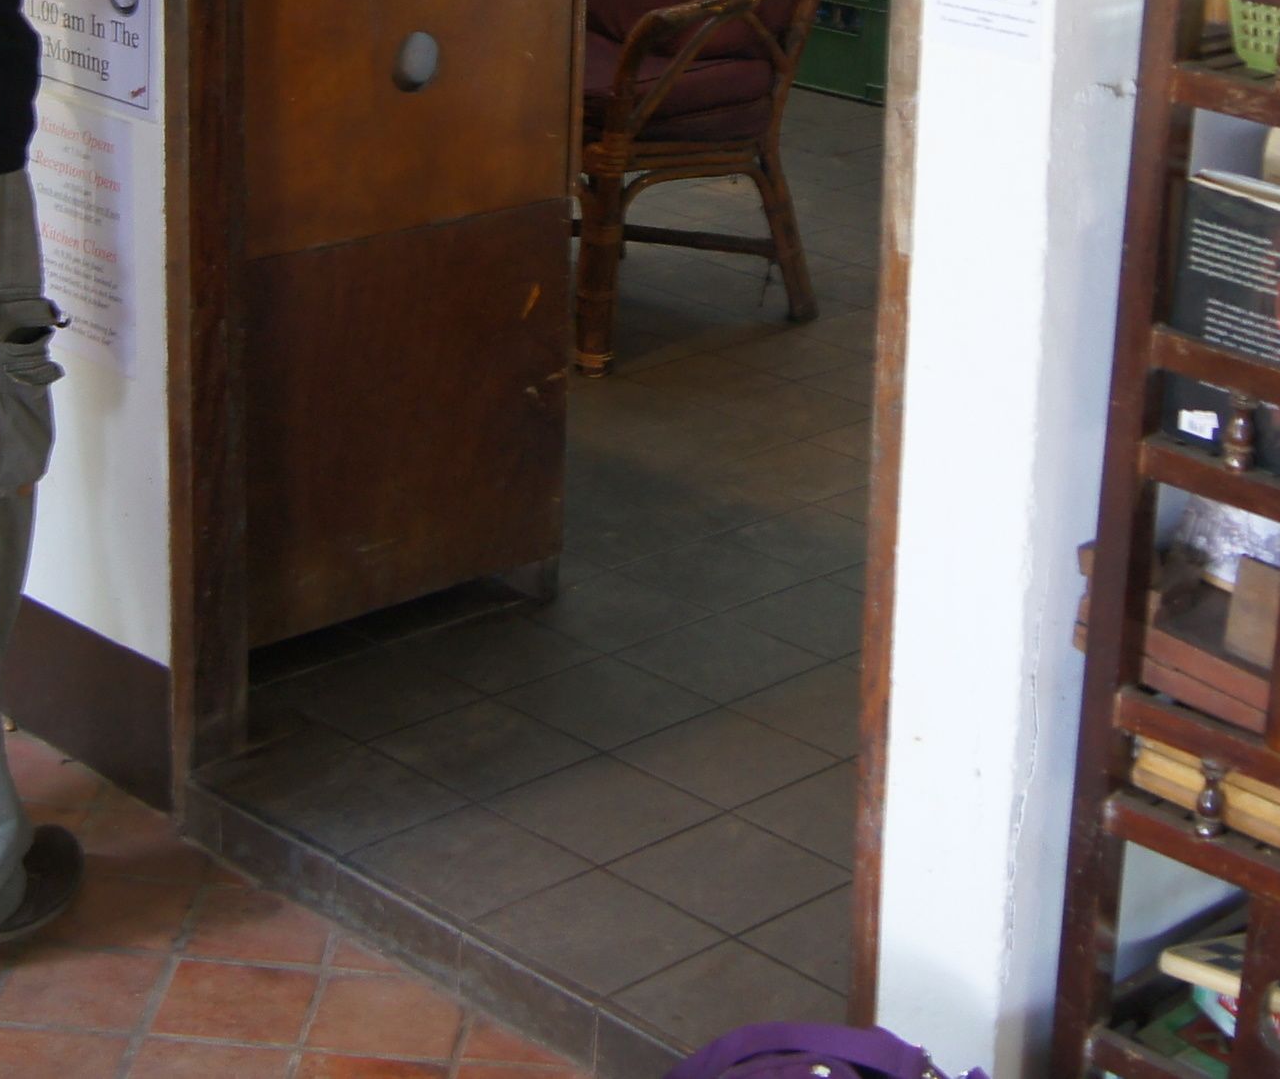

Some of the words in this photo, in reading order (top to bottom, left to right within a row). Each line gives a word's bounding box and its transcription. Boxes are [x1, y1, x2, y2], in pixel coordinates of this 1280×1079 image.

[62, 12, 84, 32] am
[91, 14, 105, 38] In
[111, 20, 139, 49] The
[46, 36, 110, 81] Morning
[40, 116, 80, 139] Kitchen
[82, 130, 115, 154] Opens
[36, 149, 87, 178] Reception
[88, 170, 121, 192] Opens
[42, 221, 80, 250] Kitchen
[83, 238, 118, 263] Closes
